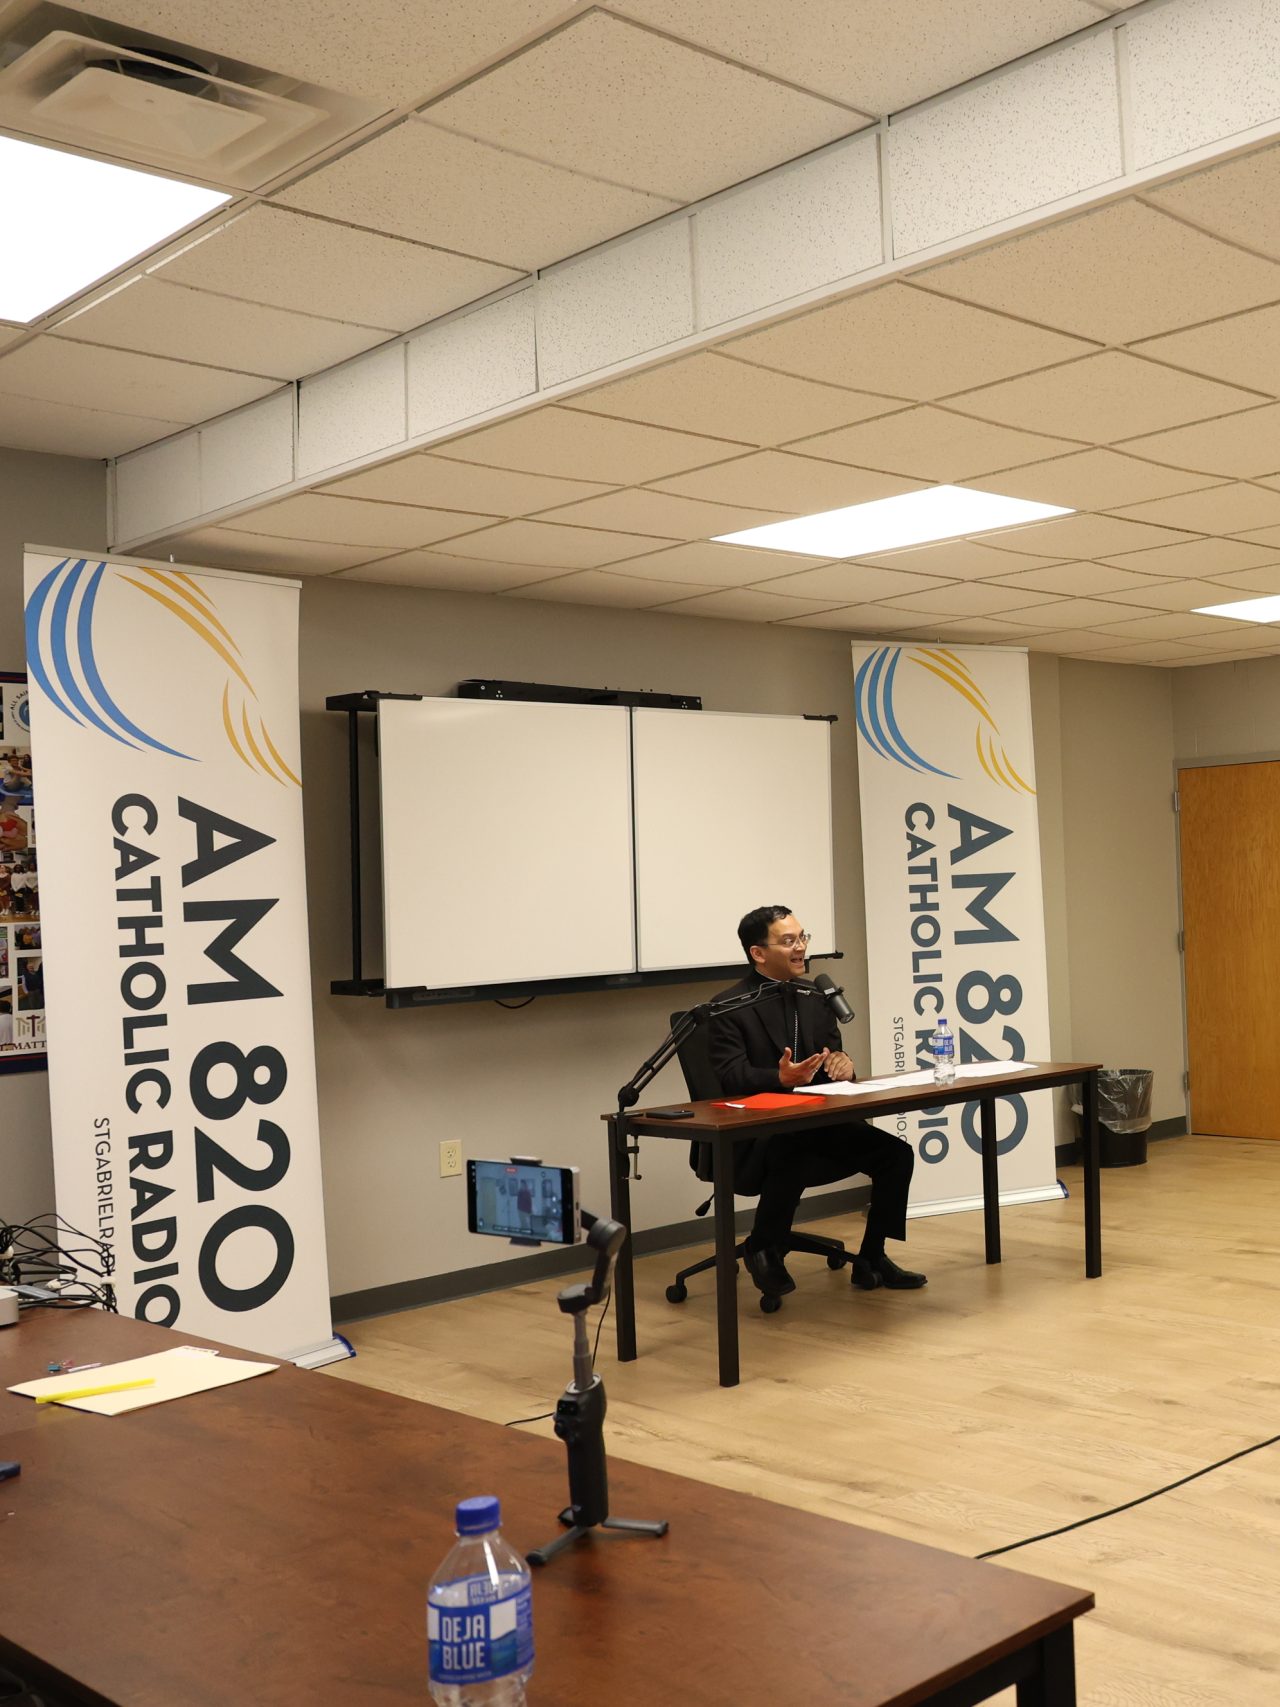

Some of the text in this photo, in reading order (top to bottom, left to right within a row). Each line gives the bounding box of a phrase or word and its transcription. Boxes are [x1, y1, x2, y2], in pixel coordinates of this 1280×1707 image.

[905, 802, 943, 1016] CATHOLIC
[947, 804, 1019, 945] AM
[112, 794, 181, 1329] CATHOLIC RADIO
[178, 796, 294, 1312] AM 820
[442, 1614, 486, 1643] DEJA
[442, 1642, 485, 1670] BLUE
